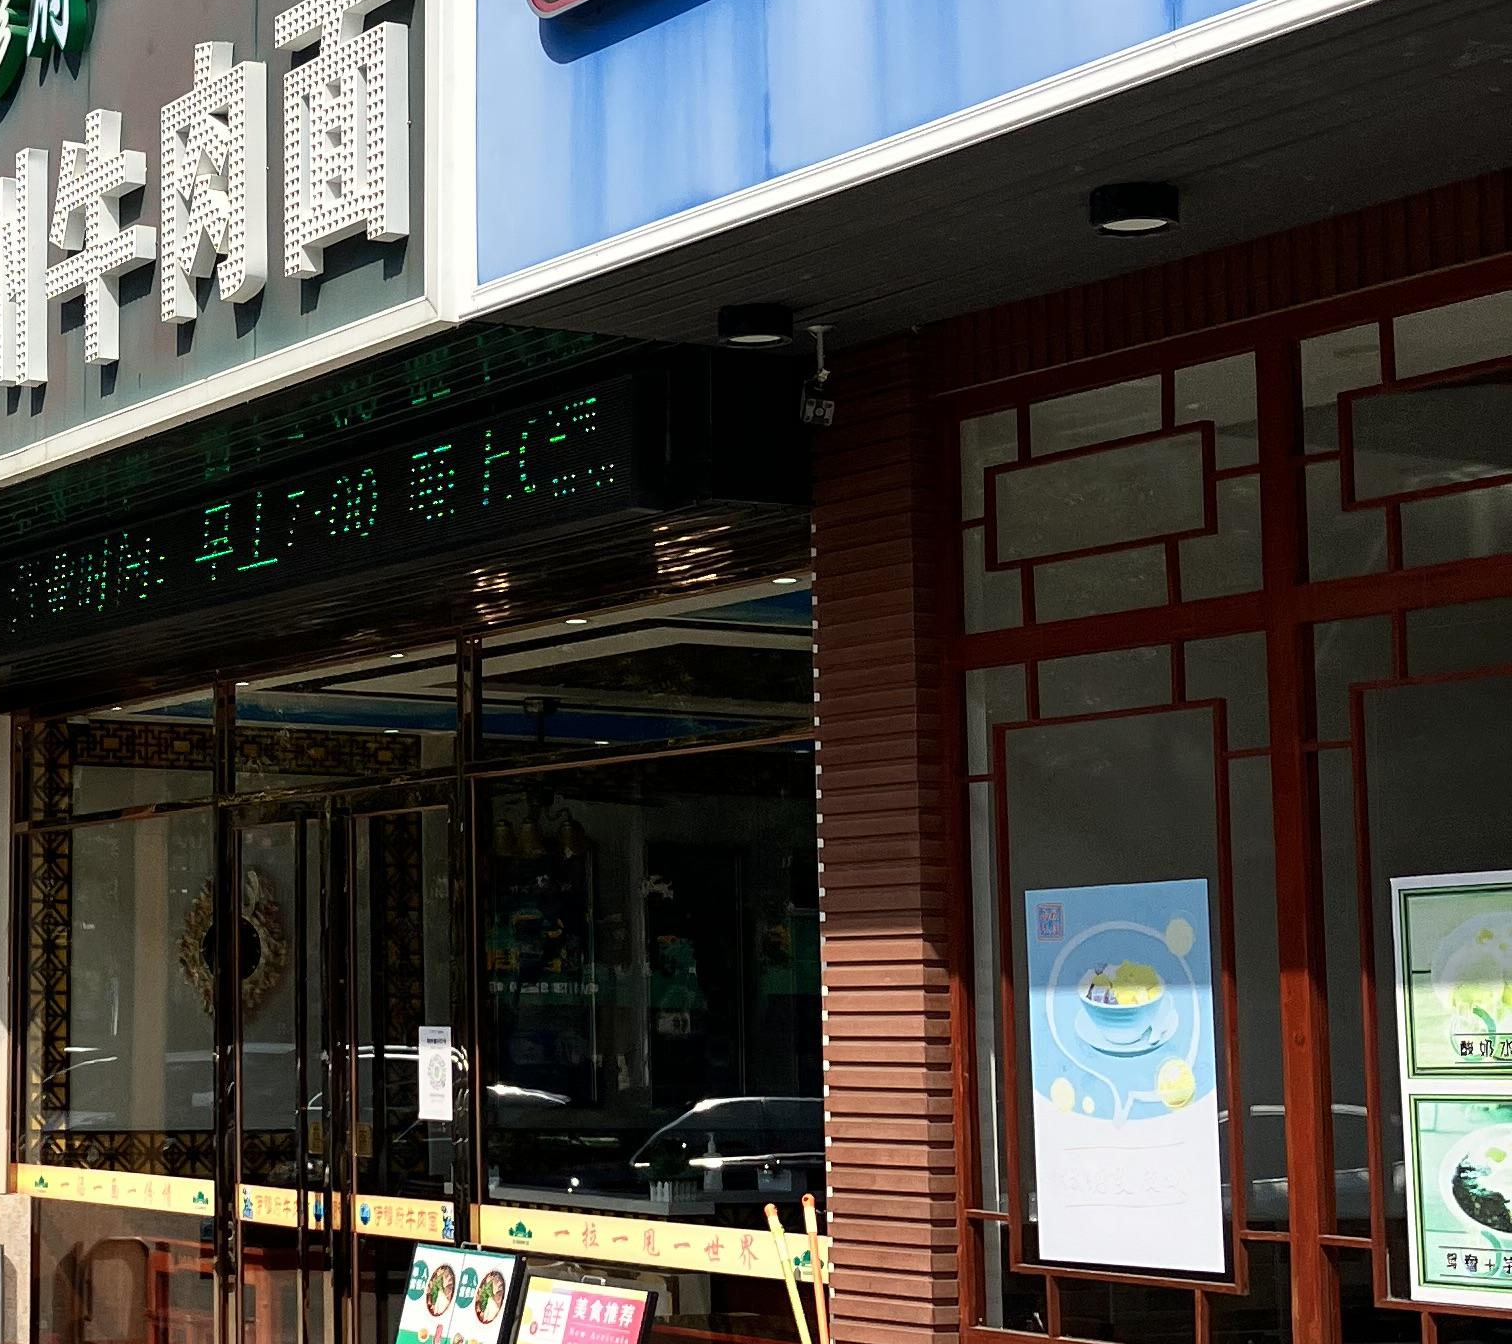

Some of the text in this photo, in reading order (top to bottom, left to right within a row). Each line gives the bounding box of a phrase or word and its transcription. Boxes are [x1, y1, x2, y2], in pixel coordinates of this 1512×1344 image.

[553, 1221, 760, 1270] 一拉一甩一世界
[572, 1297, 636, 1328] 美食推荐
